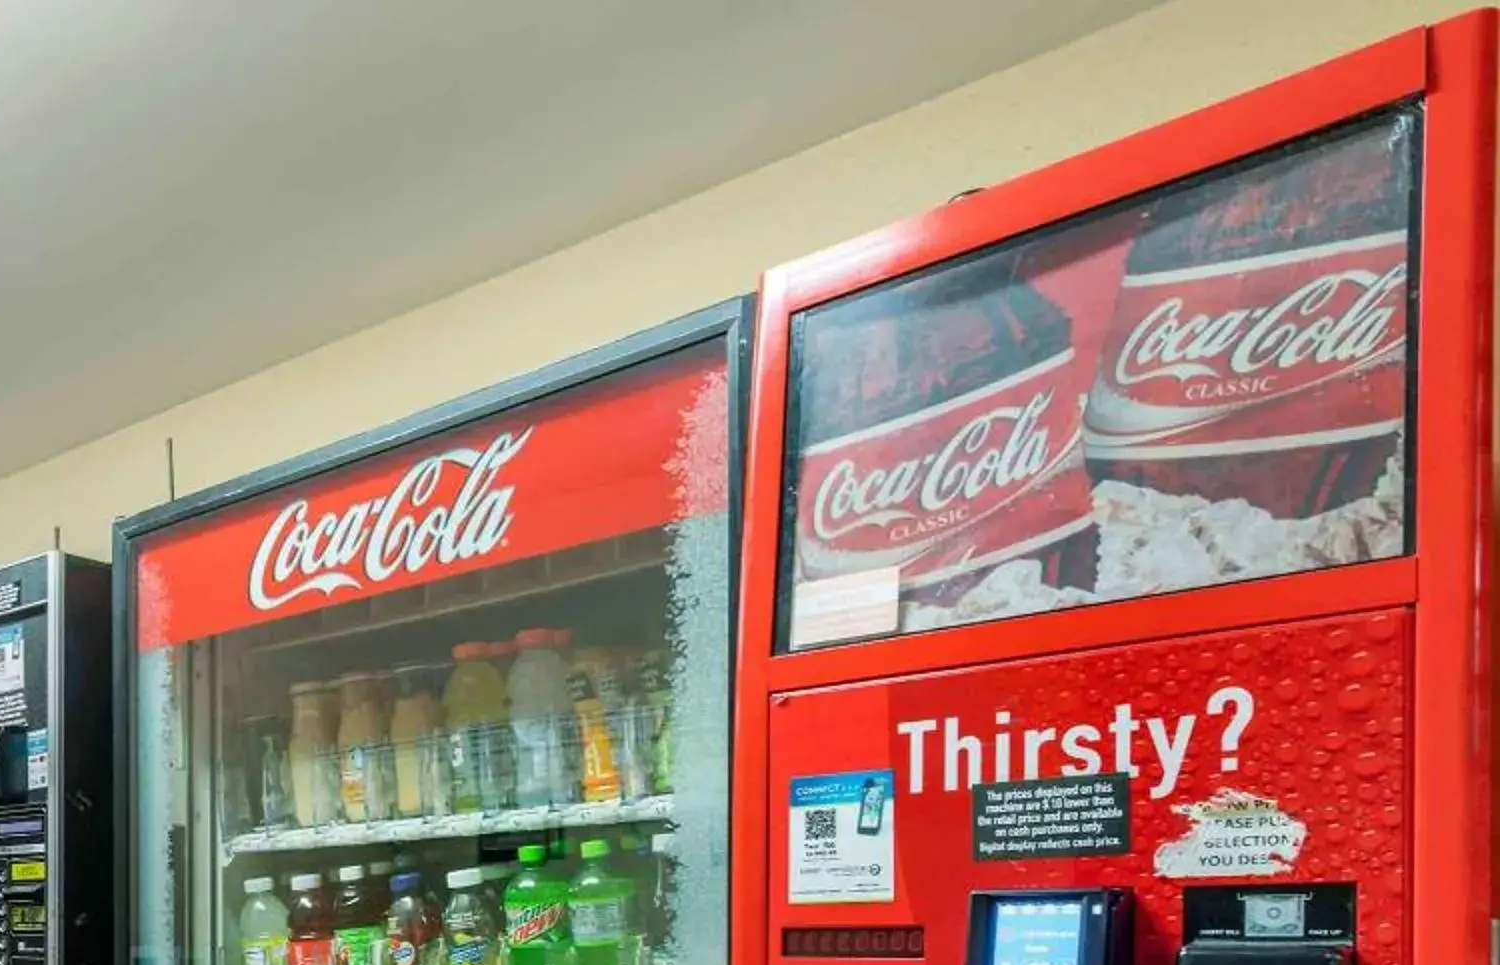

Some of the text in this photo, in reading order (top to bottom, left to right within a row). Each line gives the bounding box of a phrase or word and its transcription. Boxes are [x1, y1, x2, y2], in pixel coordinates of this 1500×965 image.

[1114, 262, 1407, 387] Coca-Cola
[1185, 374, 1277, 401] CLASSIC
[813, 386, 1057, 541] Coca-Cola
[247, 425, 534, 612] Coca-Cola
[889, 504, 971, 542] CLASSIC
[897, 686, 1255, 800] Thirsty?
[986, 781, 1113, 801] The prices displayed on this
[985, 802, 1023, 813] machine
[1026, 802, 1040, 811] are
[1064, 797, 1089, 808] lower
[1092, 796, 1114, 807] than
[977, 807, 1123, 826] the retail price and are available
[994, 828, 1007, 838] on
[1008, 825, 1030, 837] cash
[1031, 822, 1080, 838] purchases
[1006, 839, 1036, 853] display
[1038, 837, 1071, 849] reflects
[1072, 836, 1094, 847] cash
[1199, 855, 1233, 867] YOU
